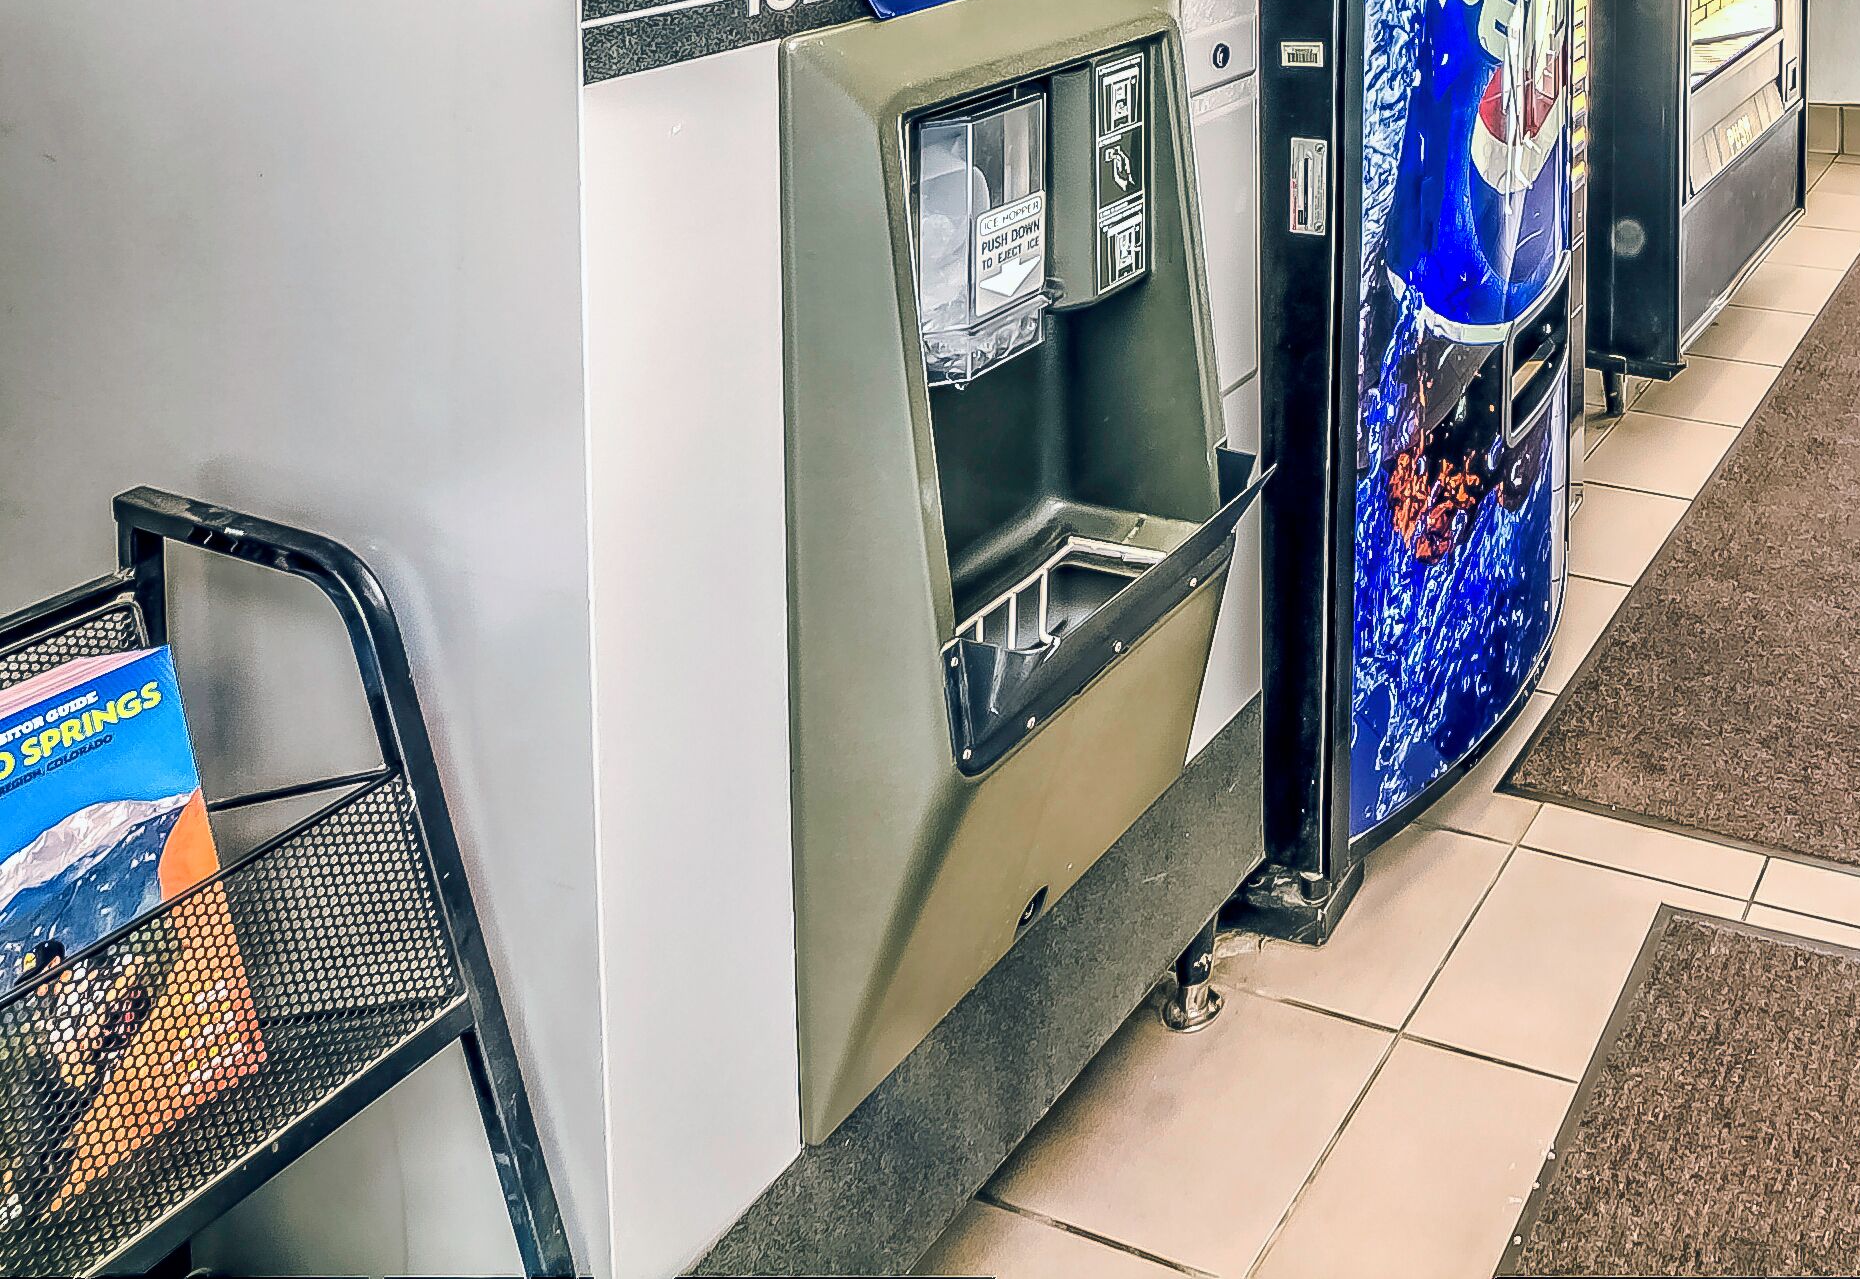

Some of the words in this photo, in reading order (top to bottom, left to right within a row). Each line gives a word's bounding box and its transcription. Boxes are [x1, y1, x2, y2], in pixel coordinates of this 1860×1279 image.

[984, 216, 999, 230] ICE
[1002, 200, 1039, 224] HOPPER
[981, 231, 1008, 256] PUSH
[1011, 218, 1040, 242] DOWN
[982, 257, 993, 271] TO
[998, 243, 1022, 264] EJECT
[1027, 236, 1040, 250] ICE
[20, 681, 163, 767] SPRINGS
[45, 690, 99, 723] GUIDE
[46, 733, 114, 772] COLORADO
